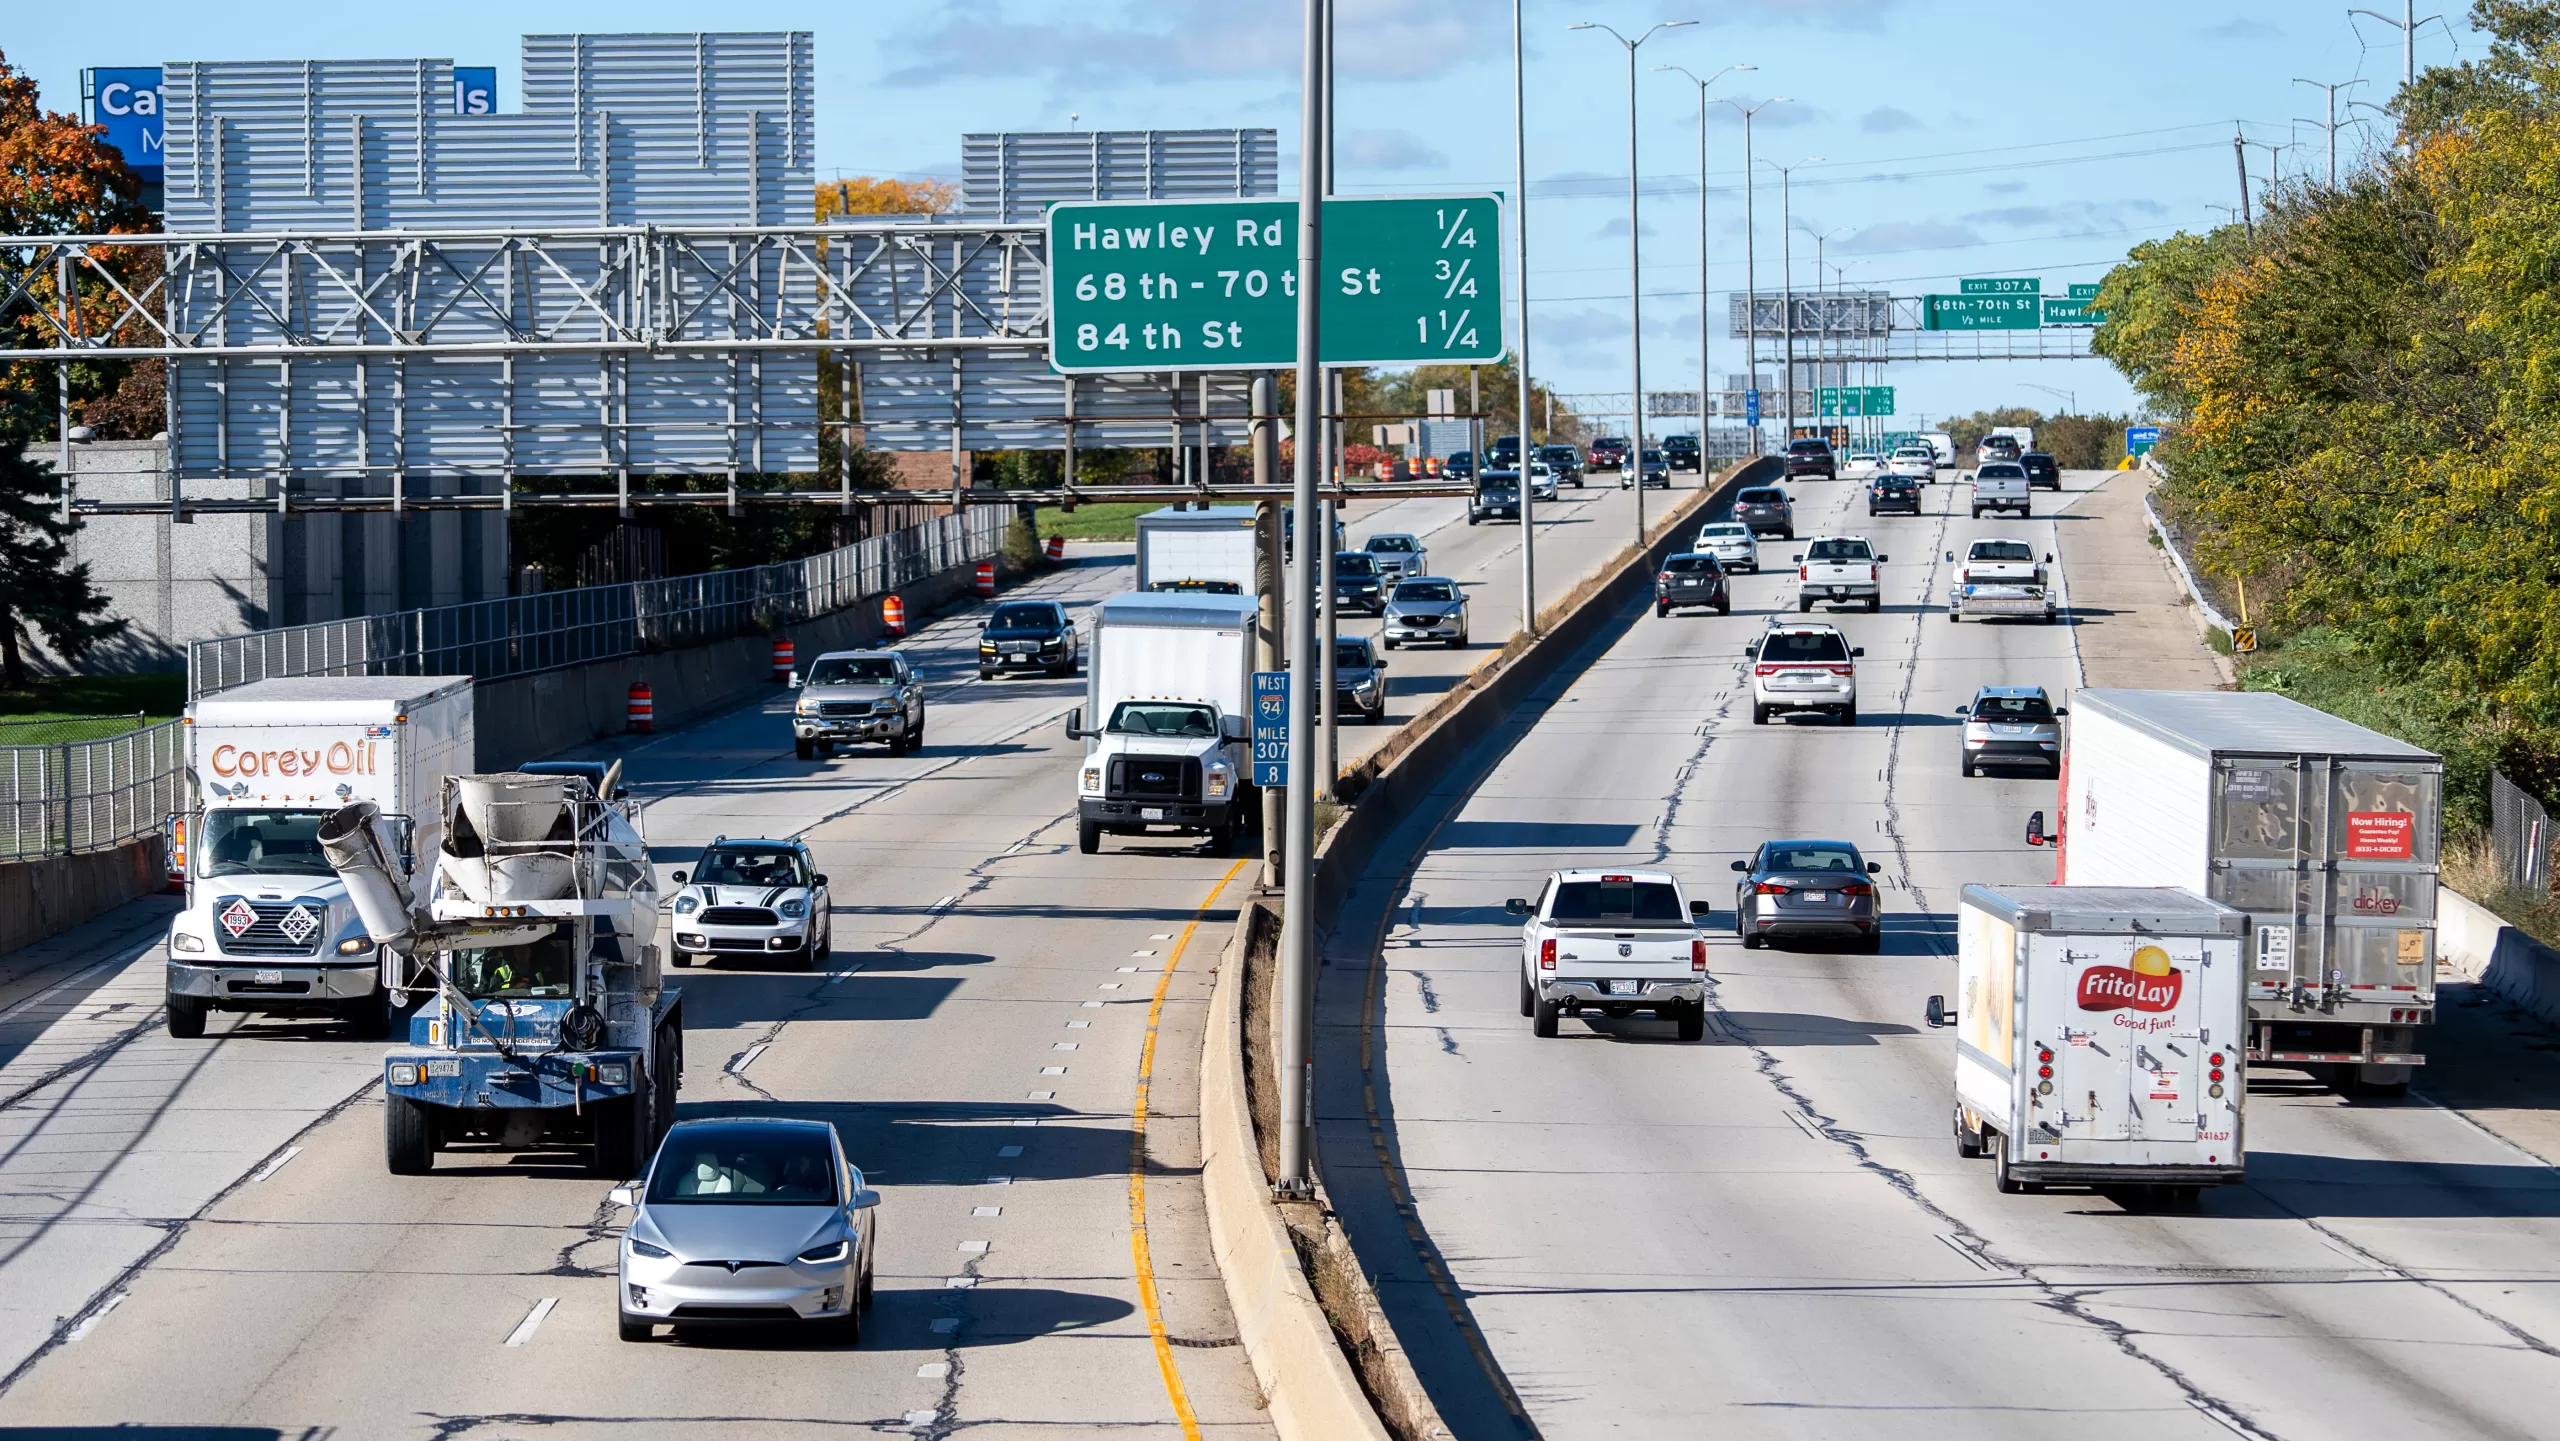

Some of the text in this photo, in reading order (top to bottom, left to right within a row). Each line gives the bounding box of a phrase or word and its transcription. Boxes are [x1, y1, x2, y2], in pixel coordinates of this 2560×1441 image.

[1074, 221, 1215, 255] Hawley
[1236, 219, 1282, 247] Rd
[1341, 267, 1381, 296] St
[1968, 283, 1987, 291] EXIT
[2076, 288, 2096, 297] EXIT
[2016, 298, 2031, 310] St
[1980, 316, 2002, 324] MILE
[2050, 306, 2096, 320] Hawly
[1077, 322, 1181, 351] 84th
[1202, 320, 1243, 349] St
[1257, 675, 1286, 691] WEST
[1261, 701, 1281, 715] 94
[1257, 727, 1287, 740] MILE
[1257, 742, 1289, 759] 307
[212, 738, 377, 778] Corey Oil
[2351, 817, 2407, 829] Now Hiring!
[2353, 887, 2402, 915] dickey
[229, 915, 247, 926] 1993
[2113, 1013, 2176, 1035] Good fun!
[434, 1064, 454, 1073] 29474
[2198, 1131, 2230, 1141] R41637
